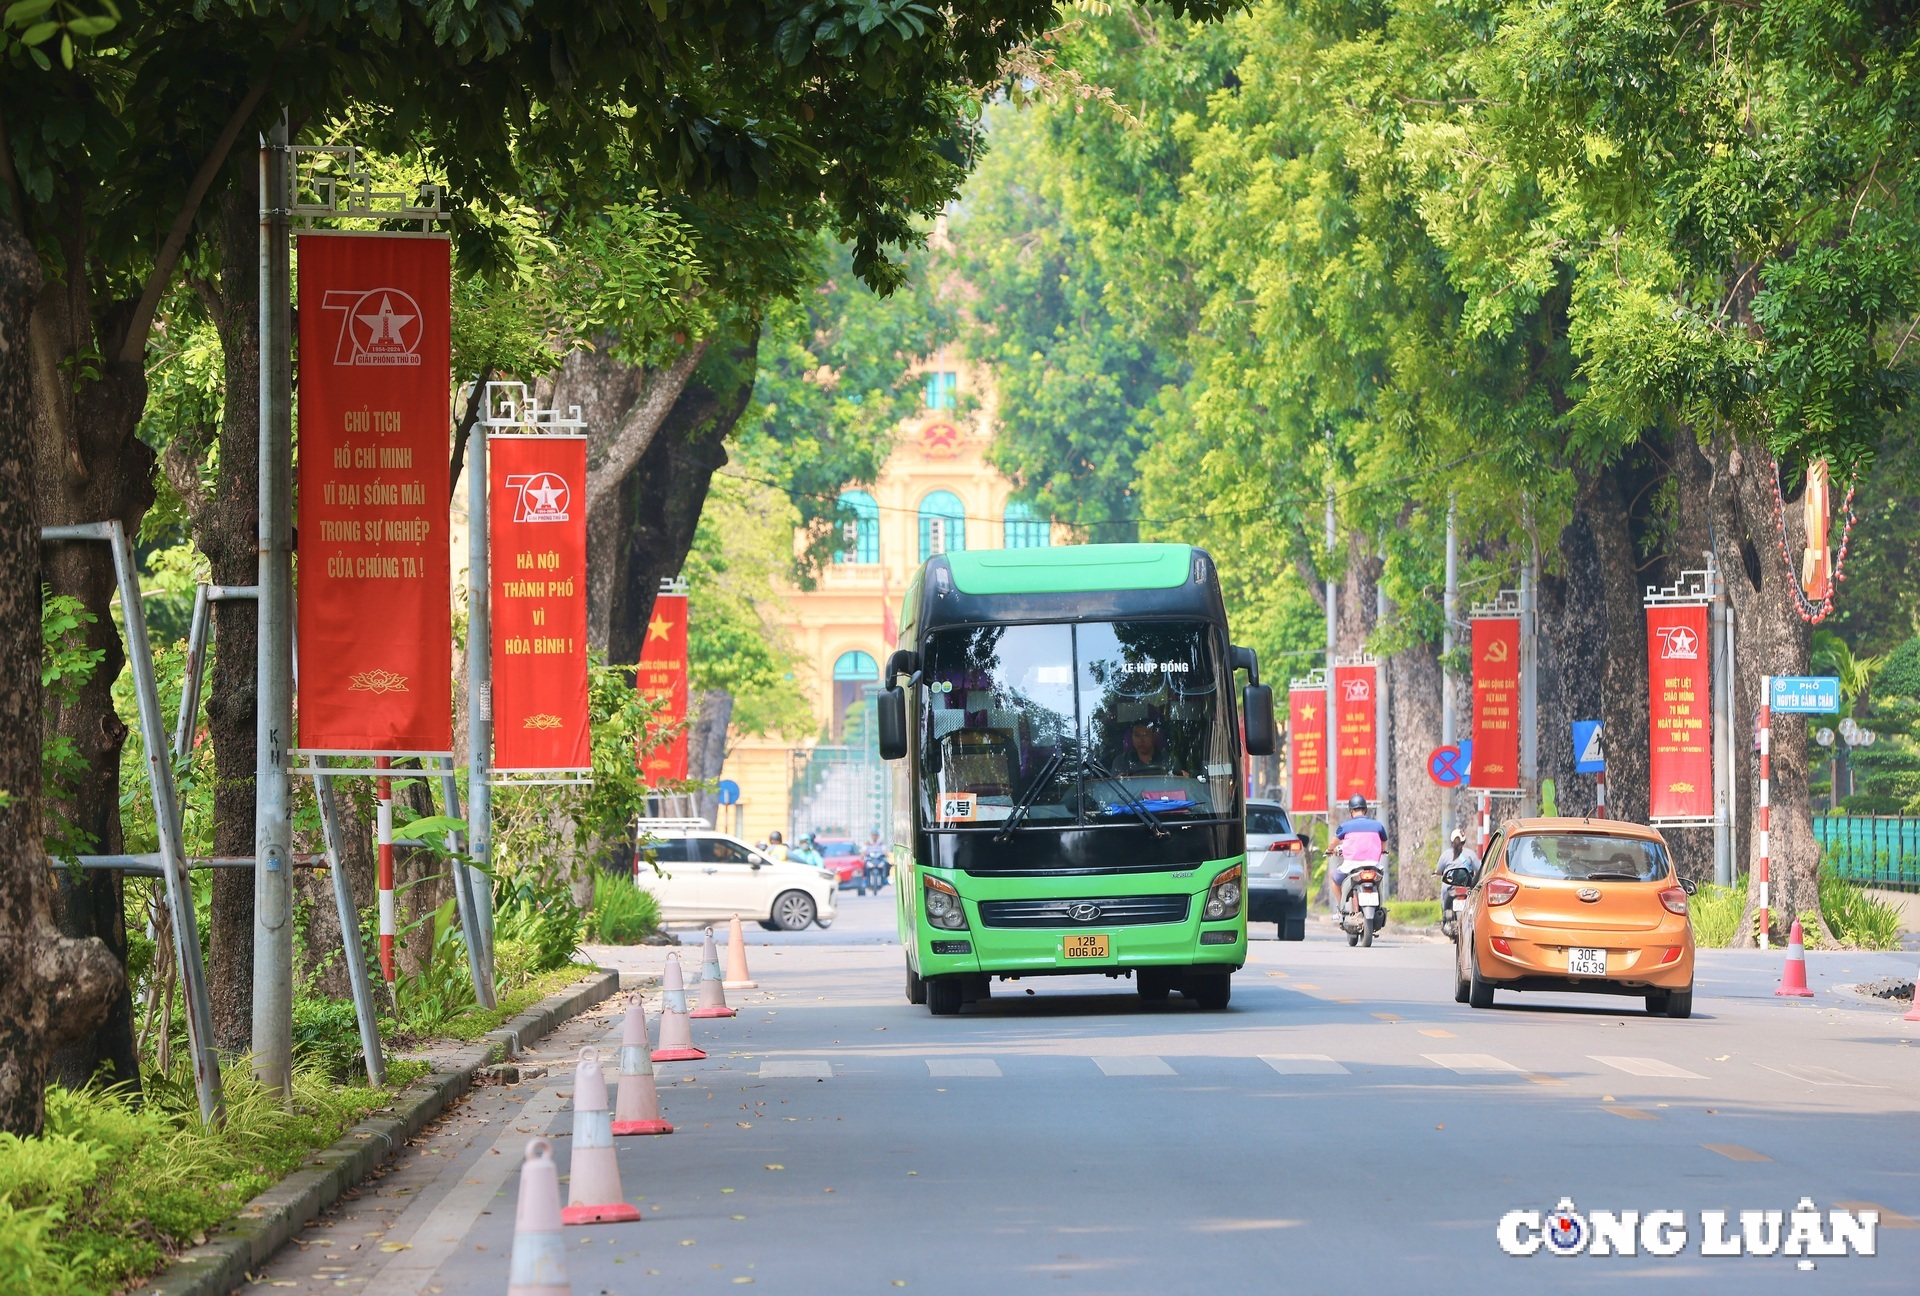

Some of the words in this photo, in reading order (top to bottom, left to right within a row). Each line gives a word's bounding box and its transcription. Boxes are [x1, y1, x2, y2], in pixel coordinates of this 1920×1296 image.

[357, 354, 371, 364] GIẢI
[397, 354, 409, 364] THỦ
[410, 354, 420, 364] ĐÔ
[344, 404, 370, 432] CHỦ
[373, 411, 400, 437] TỊCH
[333, 440, 351, 468] HỒ
[354, 444, 376, 468] CHÍ
[380, 447, 412, 468] MINH
[323, 480, 336, 505] VĨ
[338, 484, 360, 510] ĐẠI
[364, 477, 398, 505] SỐNG
[401, 480, 426, 505] MÃI
[320, 520, 361, 542] TRONG
[364, 518, 384, 546] SỰ
[385, 516, 430, 546] NGHIỆP
[327, 550, 354, 578] CỦA
[357, 553, 399, 578] CHÚNG
[402, 557, 417, 578] TA
[516, 550, 534, 569] HÀ
[537, 550, 560, 572] NỘI
[502, 578, 545, 598] THÀNH
[548, 576, 574, 597] PHỐ
[532, 607, 545, 626] VÌ
[504, 634, 531, 654] HÒA
[534, 635, 565, 654] BÌNH
[1120, 662, 1134, 673] XE
[1136, 662, 1158, 675] HỢP
[1160, 659, 1189, 673] ĐỒNG
[1799, 680, 1820, 690] PHỐ
[1077, 936, 1096, 946] 12B
[1068, 947, 1104, 957] 006.02
[1578, 948, 1597, 961] 30E
[1570, 961, 1605, 974] 145.39
